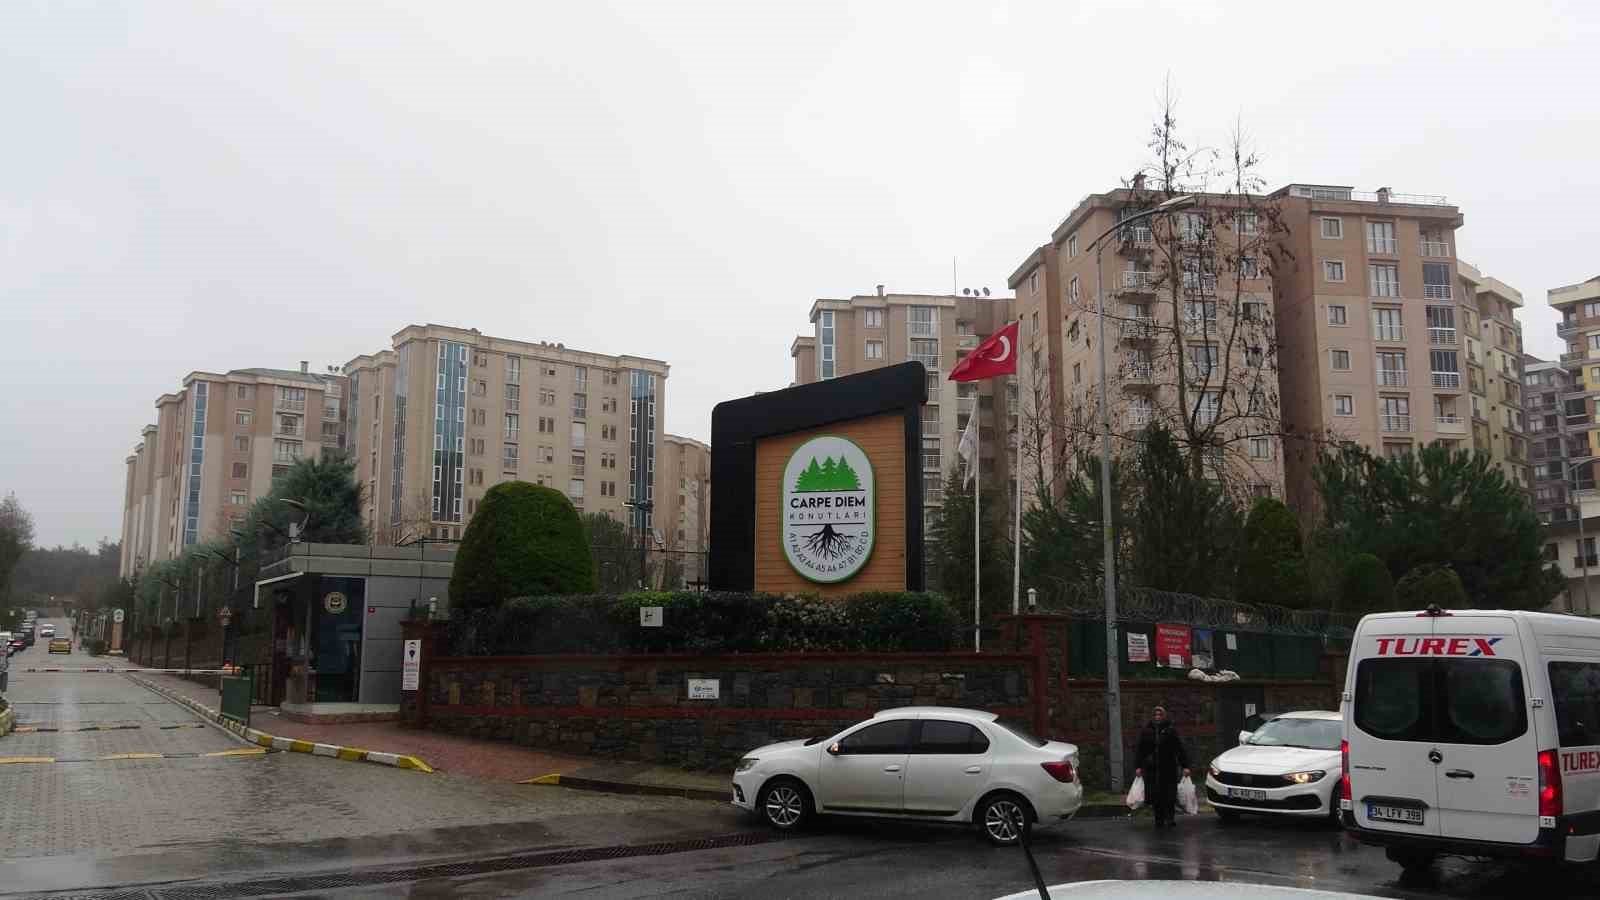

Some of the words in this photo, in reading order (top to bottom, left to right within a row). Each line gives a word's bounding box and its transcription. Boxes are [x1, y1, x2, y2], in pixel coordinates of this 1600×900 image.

[791, 498, 831, 508] CARPE
[835, 496, 865, 507] DIEM
[790, 512, 865, 520] KONUTLARI
[1376, 638, 1503, 656] TUREX
